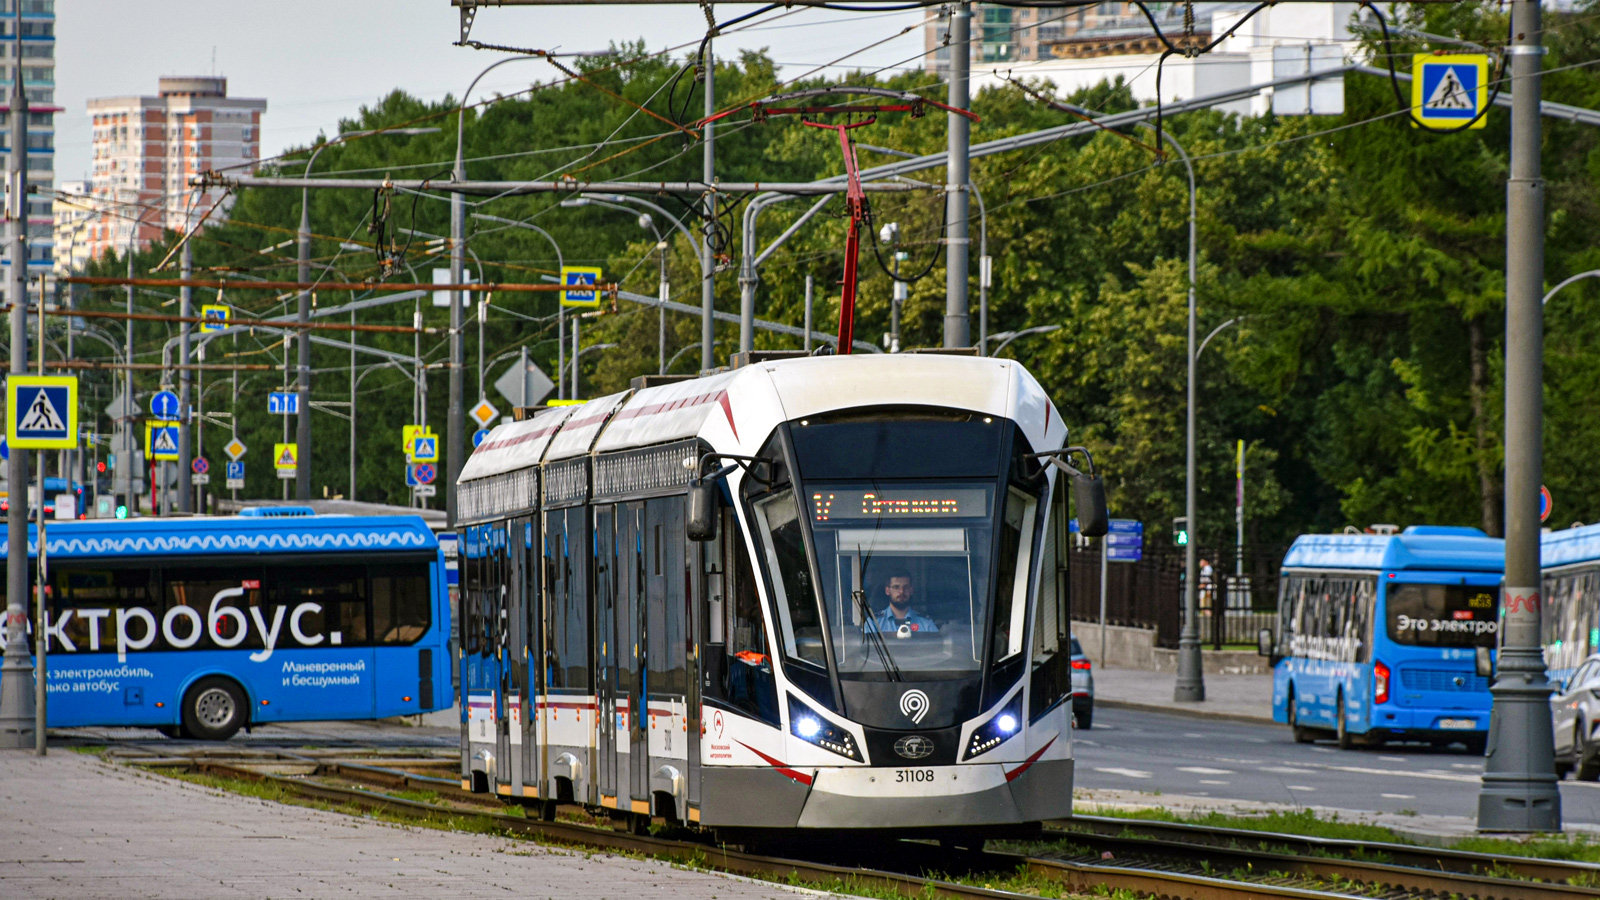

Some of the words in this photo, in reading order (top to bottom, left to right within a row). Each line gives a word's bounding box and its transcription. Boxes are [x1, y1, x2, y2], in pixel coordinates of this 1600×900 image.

[1397, 614, 1429, 632] Это
[54, 665, 154, 680] электромобиль,
[282, 659, 366, 674] Маневренный
[73, 679, 120, 694] автобус
[282, 677, 290, 686] и
[292, 673, 360, 688] бесшумный
[896, 769, 934, 782] 31108
